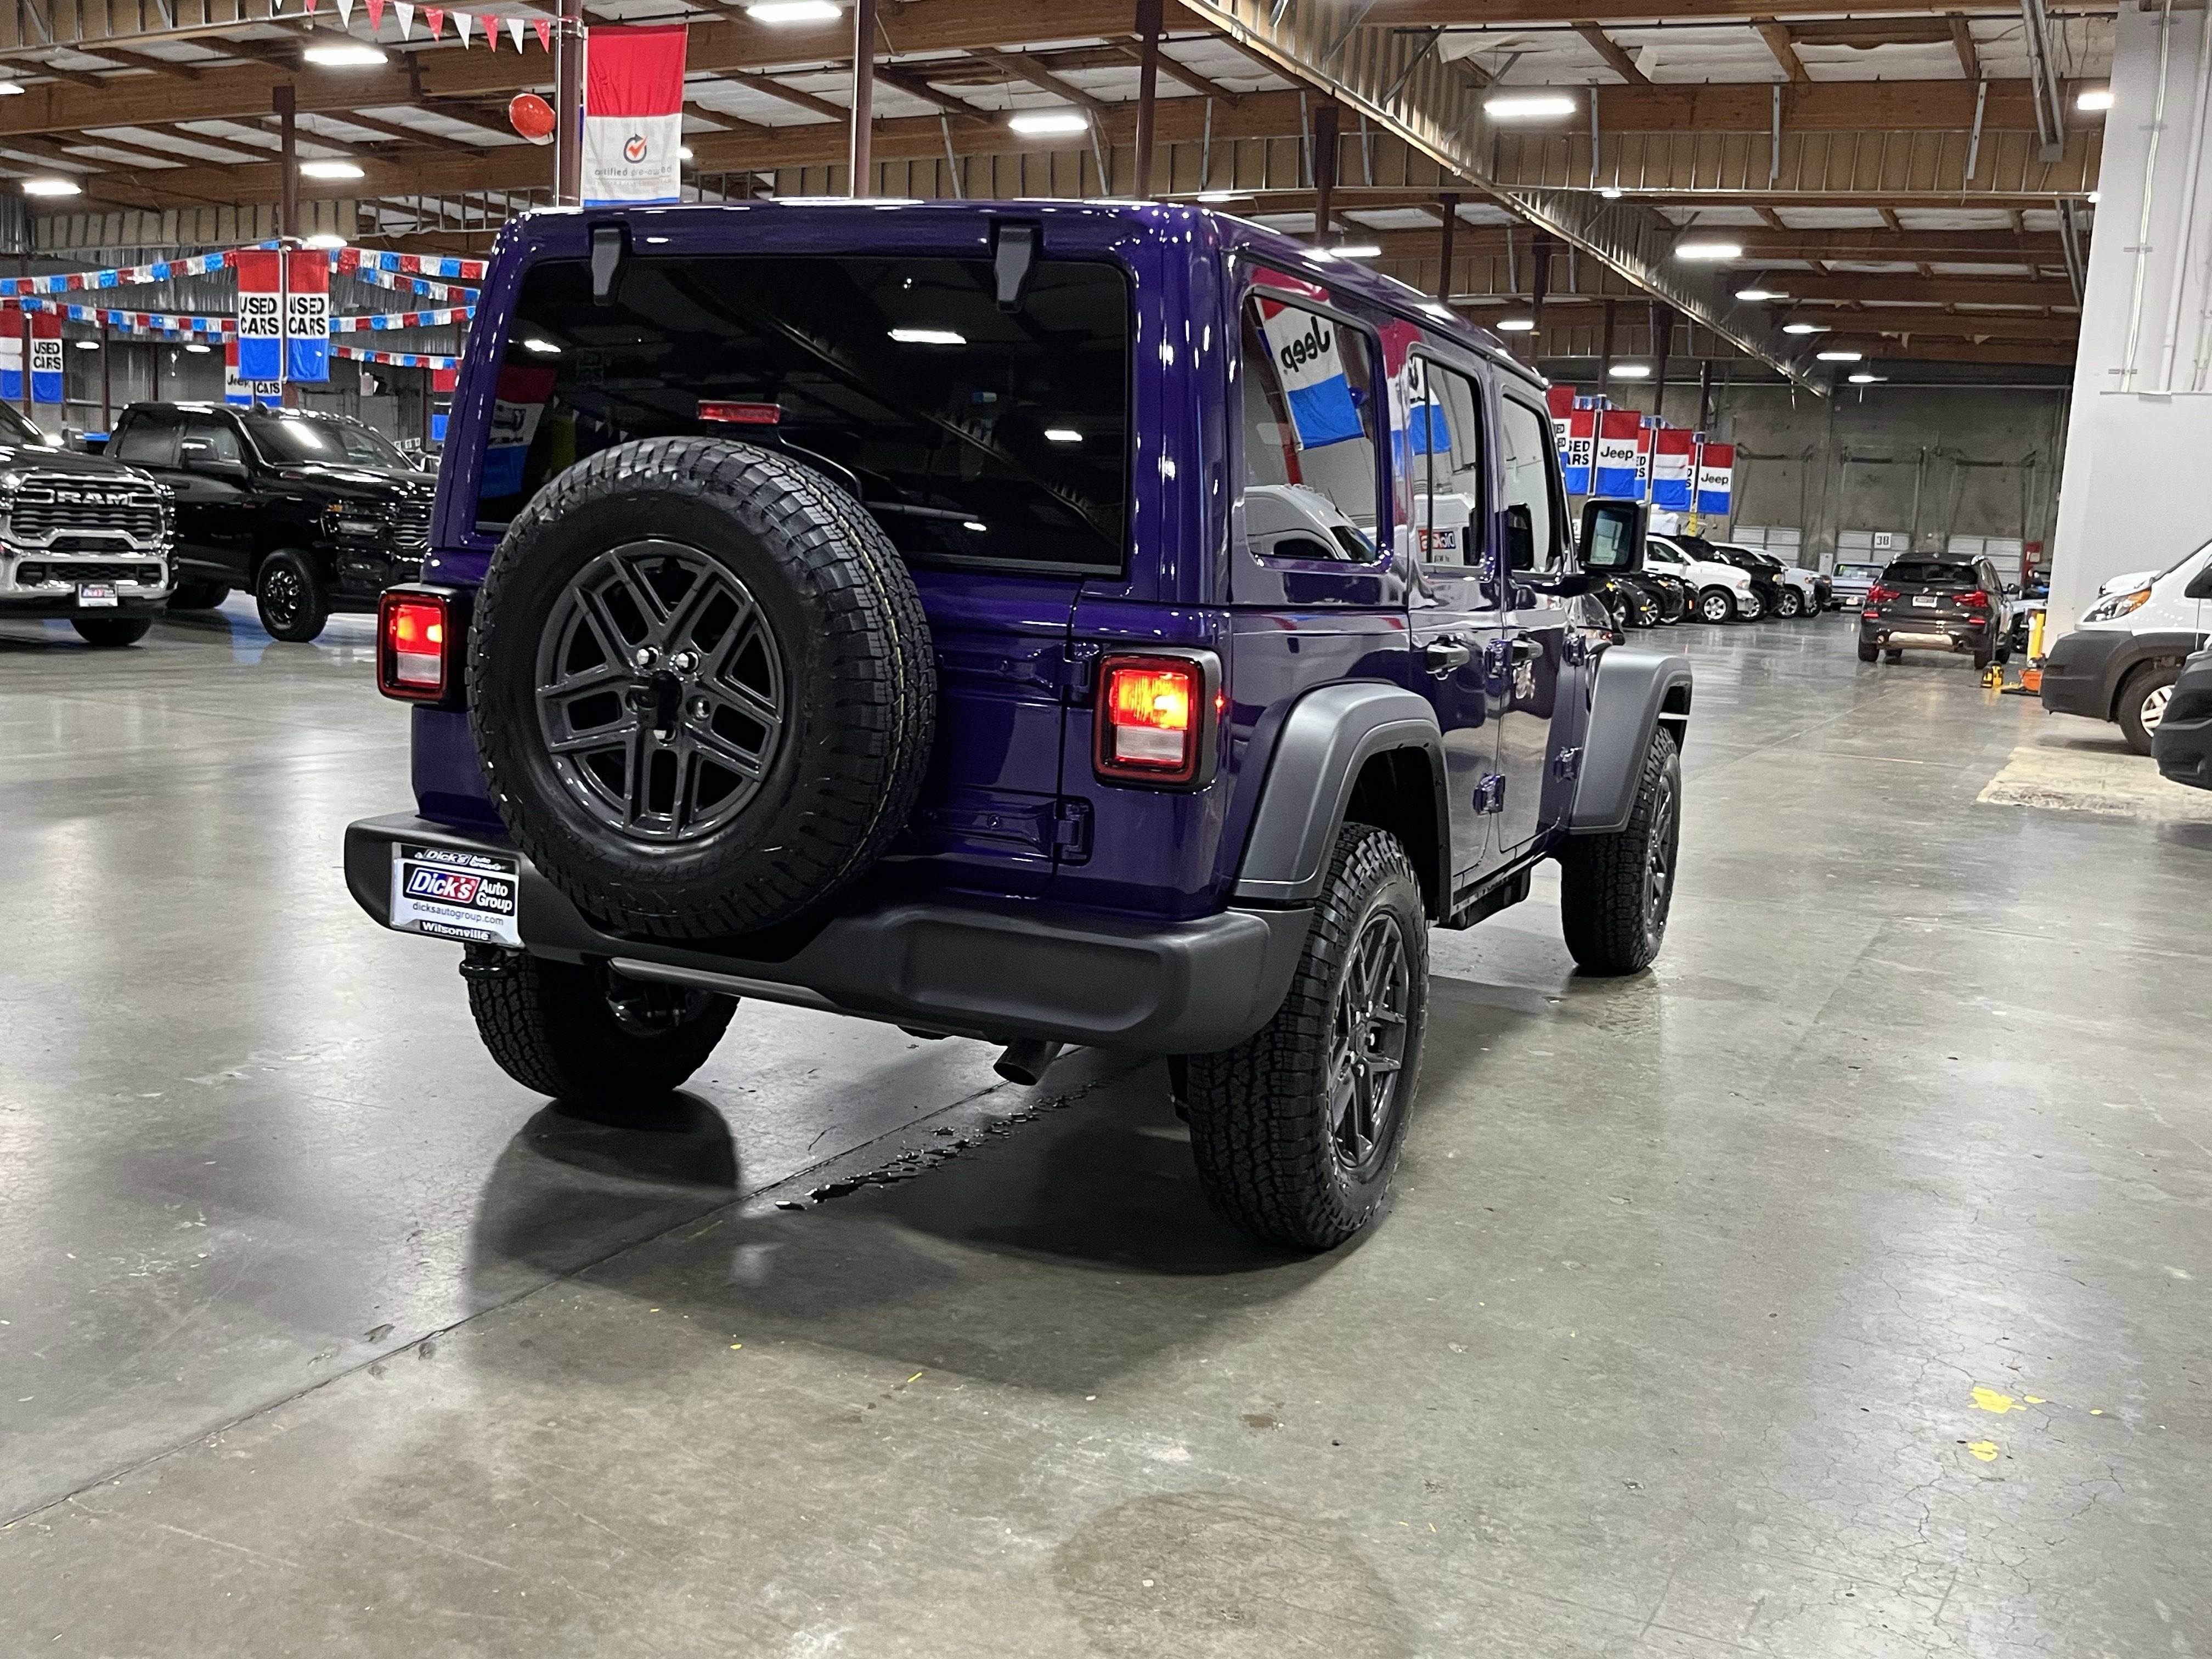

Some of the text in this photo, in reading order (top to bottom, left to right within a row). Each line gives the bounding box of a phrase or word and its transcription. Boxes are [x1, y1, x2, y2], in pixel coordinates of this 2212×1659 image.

[240, 297, 278, 315] USED
[289, 297, 325, 315] USED
[240, 316, 279, 335] CARS
[289, 317, 326, 335] CARS
[34, 342, 60, 354] USED
[1569, 441, 1590, 452] ED
[1600, 446, 1634, 461] Jeep
[1567, 453, 1589, 465] RS
[1701, 473, 1729, 486] Jeep
[57, 492, 128, 506] RAM
[426, 850, 467, 864] Dick's
[411, 871, 508, 899] Dick's Auto
[476, 892, 512, 913] Group
[413, 901, 504, 926] dicksautogroup.com
[422, 921, 490, 940] Wilsonville
